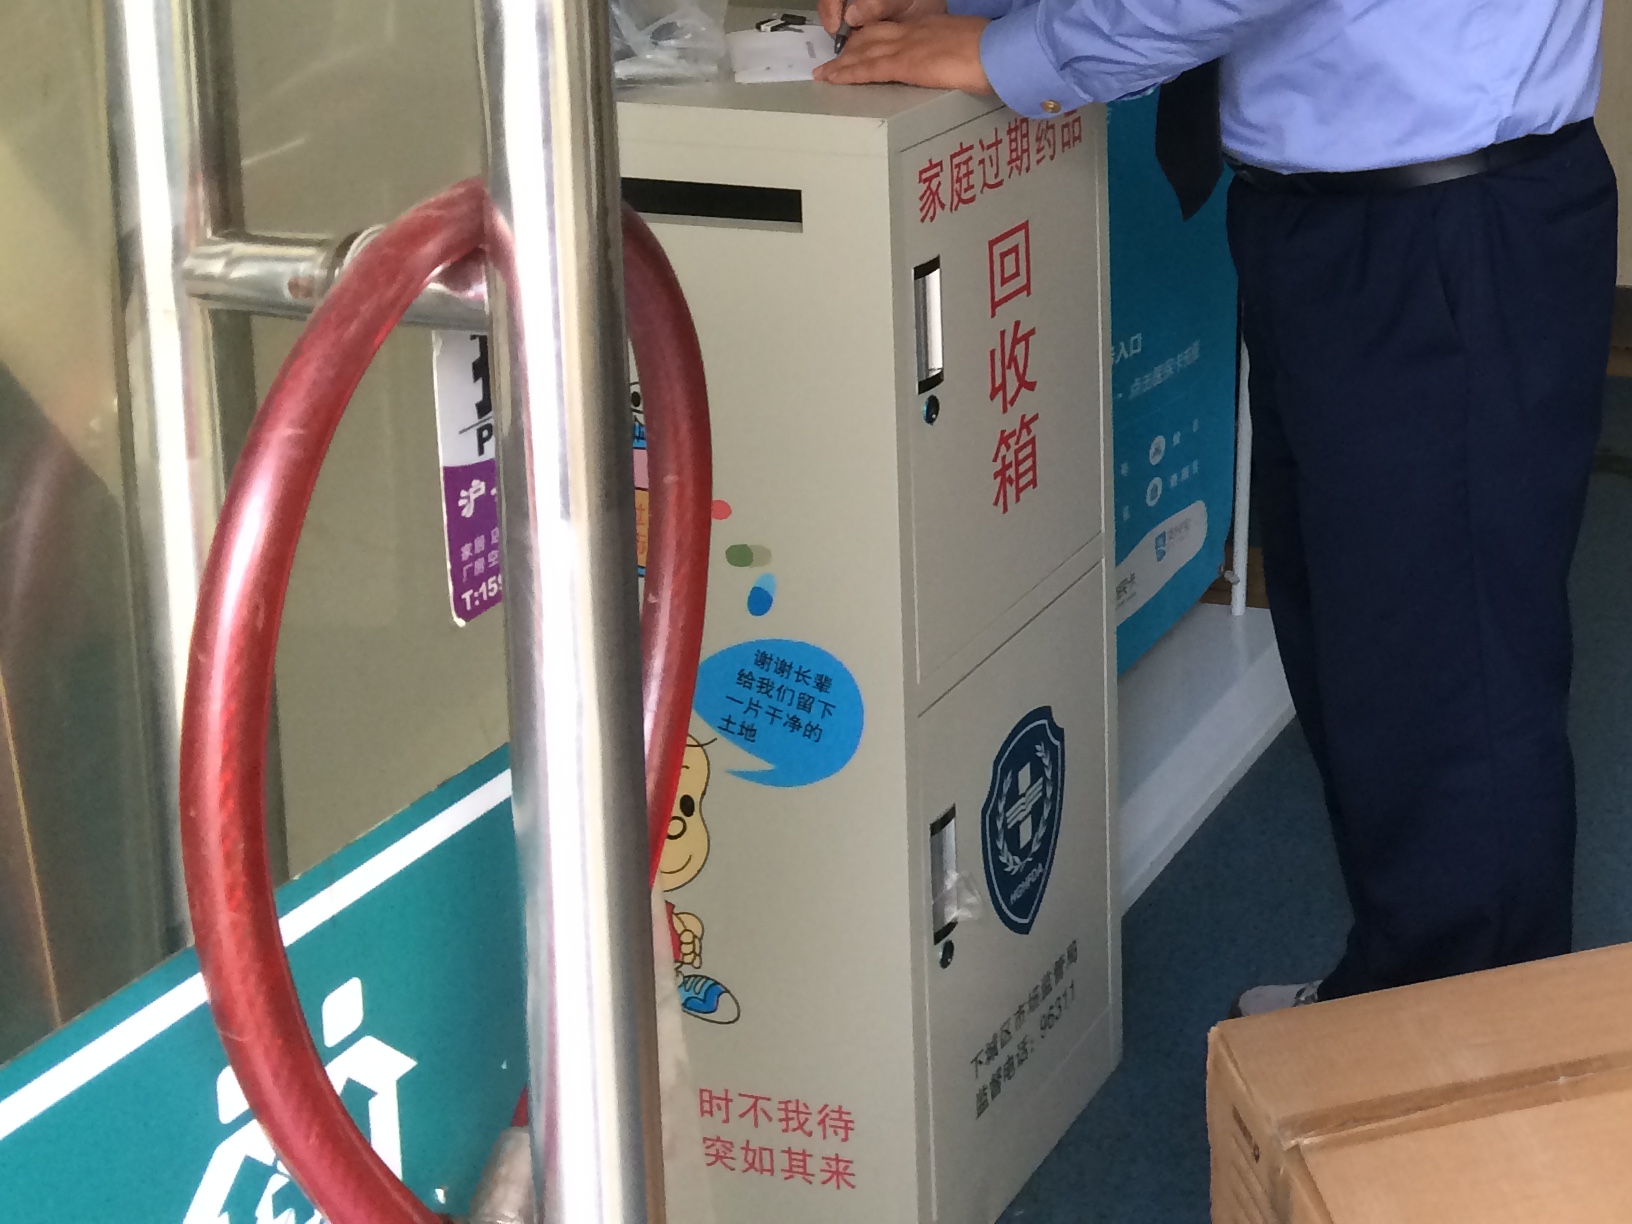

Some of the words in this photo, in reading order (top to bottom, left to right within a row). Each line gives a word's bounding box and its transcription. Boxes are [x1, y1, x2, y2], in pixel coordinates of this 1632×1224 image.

[917, 108, 1083, 224] 家庭过期药品
[987, 219, 1040, 515] 回收箱
[1111, 332, 1143, 365] 入口
[735, 667, 837, 720] 给我们留下
[753, 648, 833, 695] 谢谢长辈
[717, 713, 758, 744] 土地
[725, 694, 823, 744] 一片干净的
[698, 1086, 856, 1144] 时不我待
[701, 1134, 857, 1191] 突如其来
